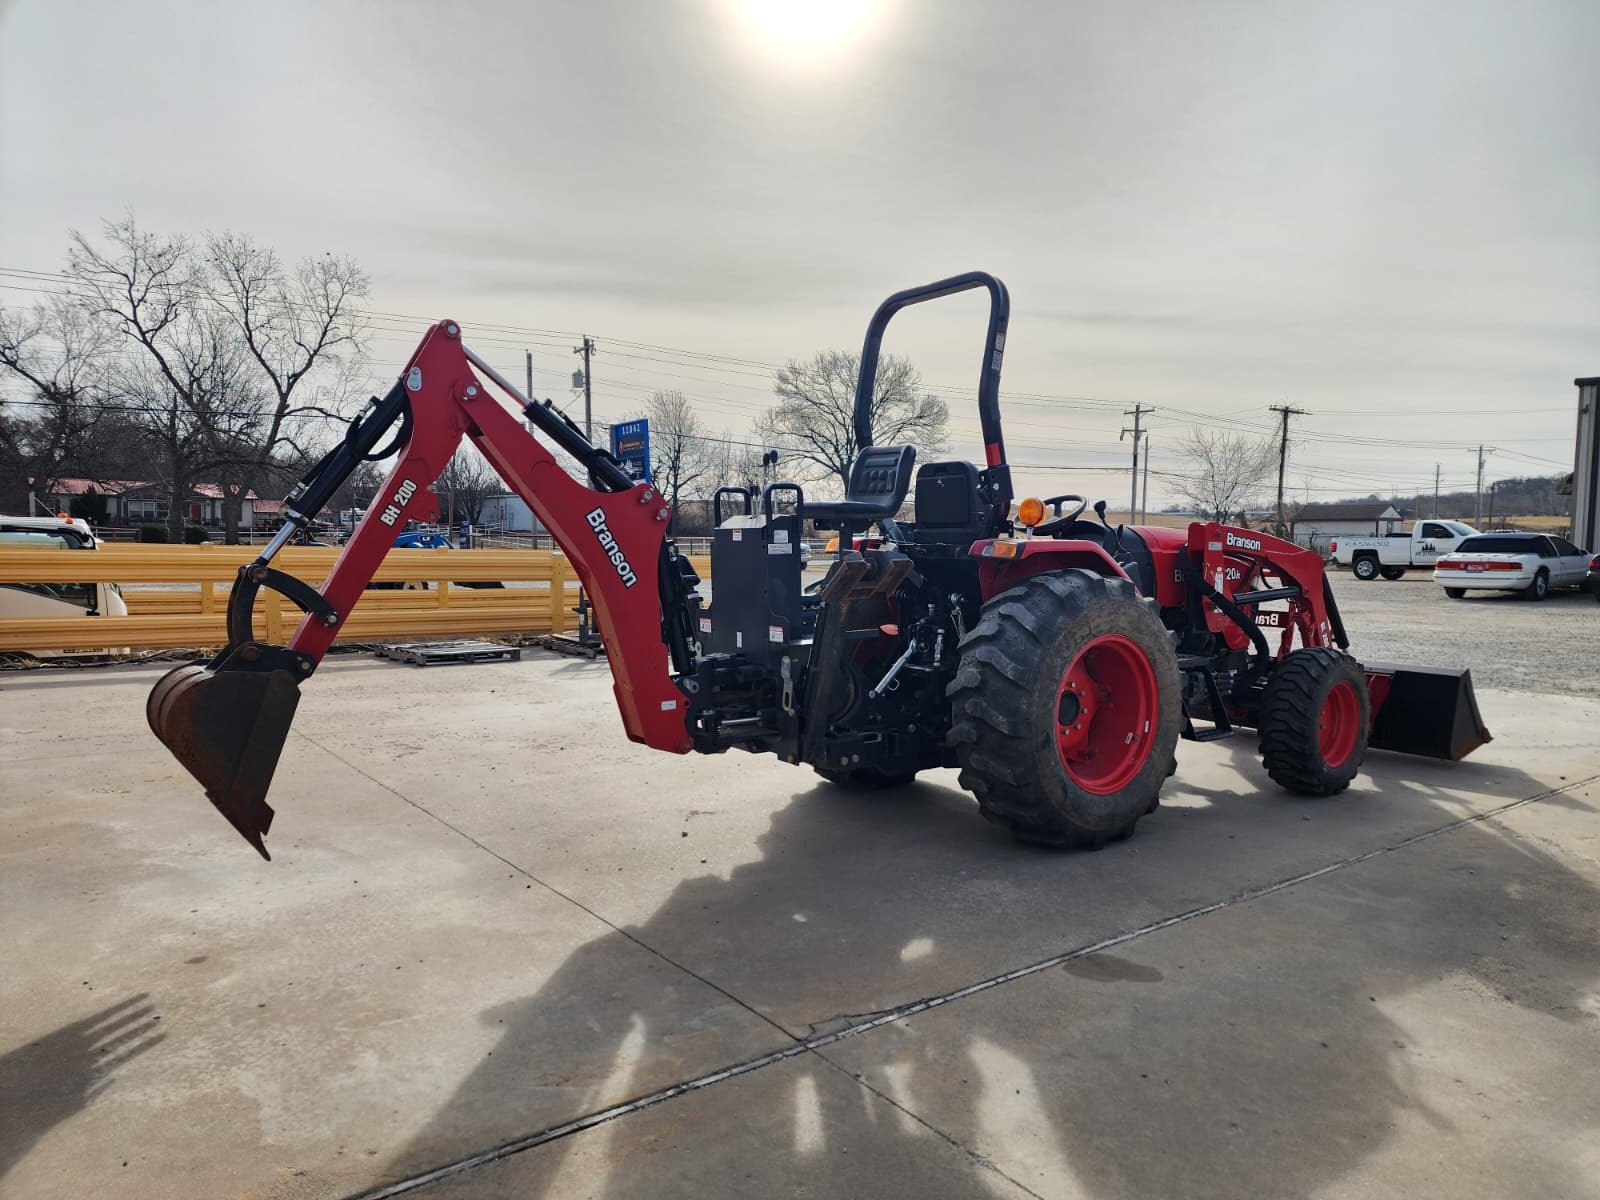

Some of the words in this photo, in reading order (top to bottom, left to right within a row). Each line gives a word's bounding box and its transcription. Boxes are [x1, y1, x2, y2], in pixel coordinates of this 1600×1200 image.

[380, 504, 401, 526] BH
[393, 479, 417, 506] 200
[586, 508, 638, 588] Branson
[1226, 532, 1261, 550] Branson
